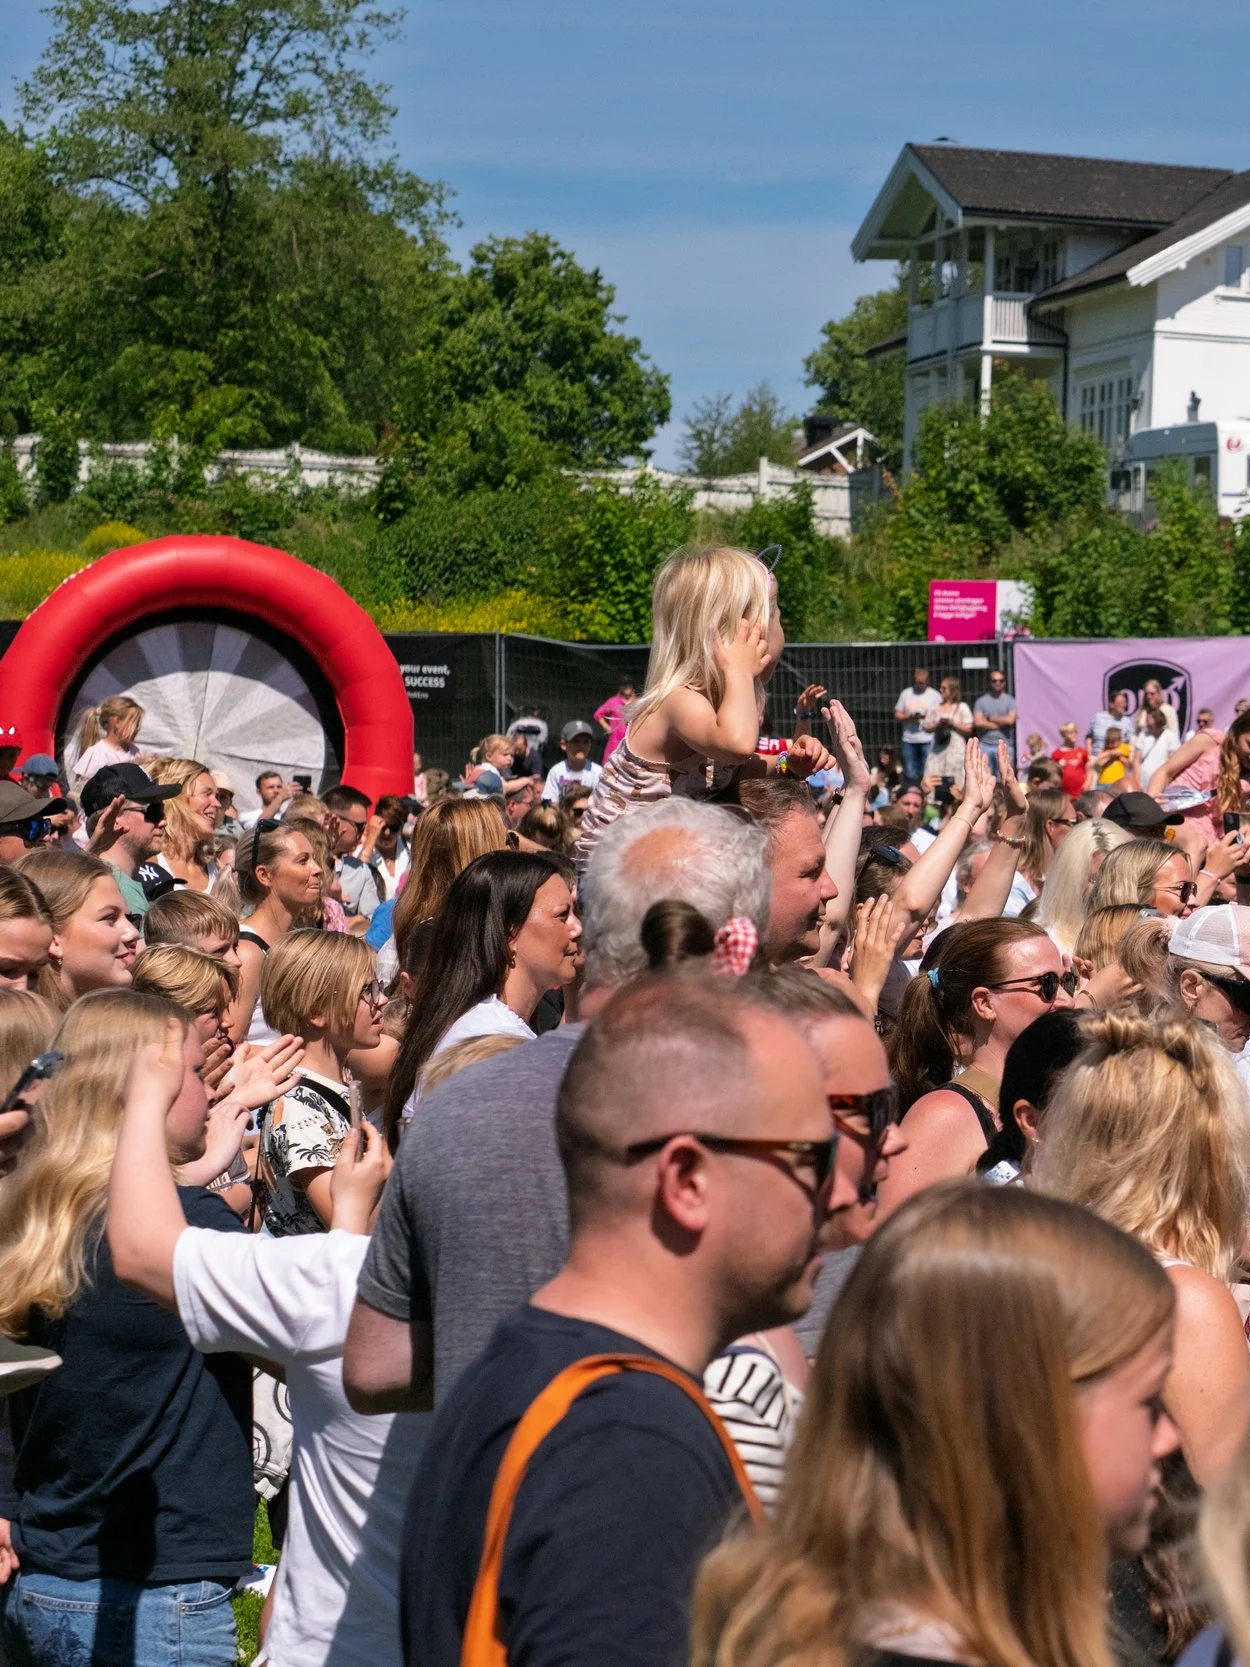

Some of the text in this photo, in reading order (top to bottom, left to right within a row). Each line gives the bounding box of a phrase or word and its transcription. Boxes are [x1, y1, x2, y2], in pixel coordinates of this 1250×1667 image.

[399, 664, 451, 676] your event,
[404, 676, 445, 689] SUCCESS
